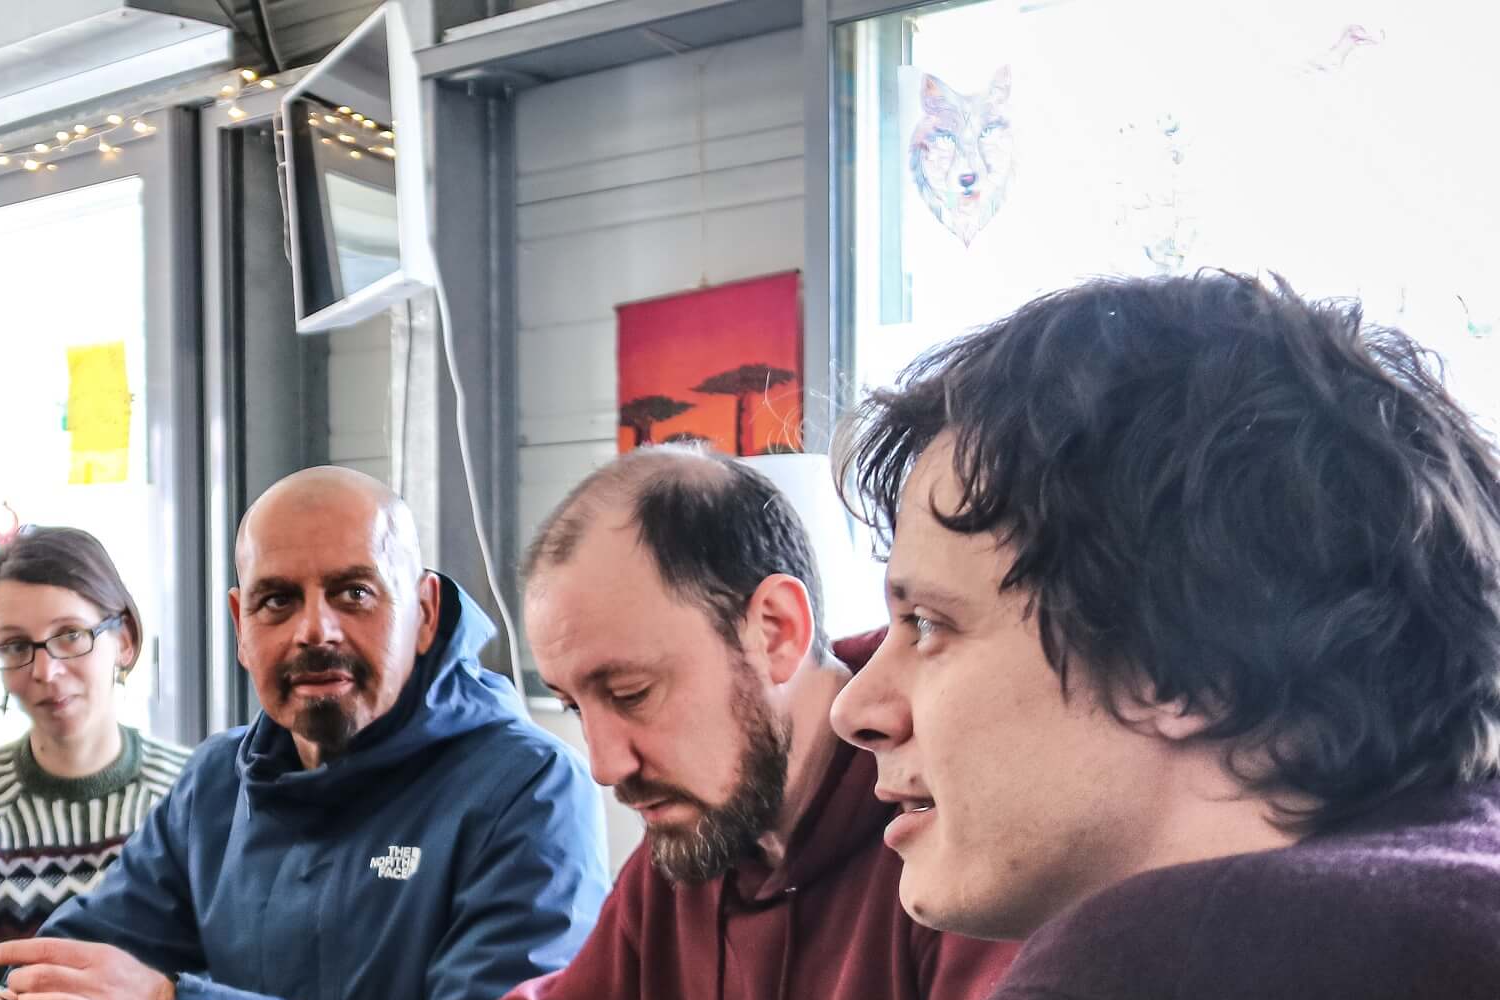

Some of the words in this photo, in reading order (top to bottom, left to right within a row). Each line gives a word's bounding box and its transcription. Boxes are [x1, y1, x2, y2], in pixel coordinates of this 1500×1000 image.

[388, 846, 412, 857] THE
[370, 856, 411, 868] NORTH
[378, 867, 410, 880] FACE
